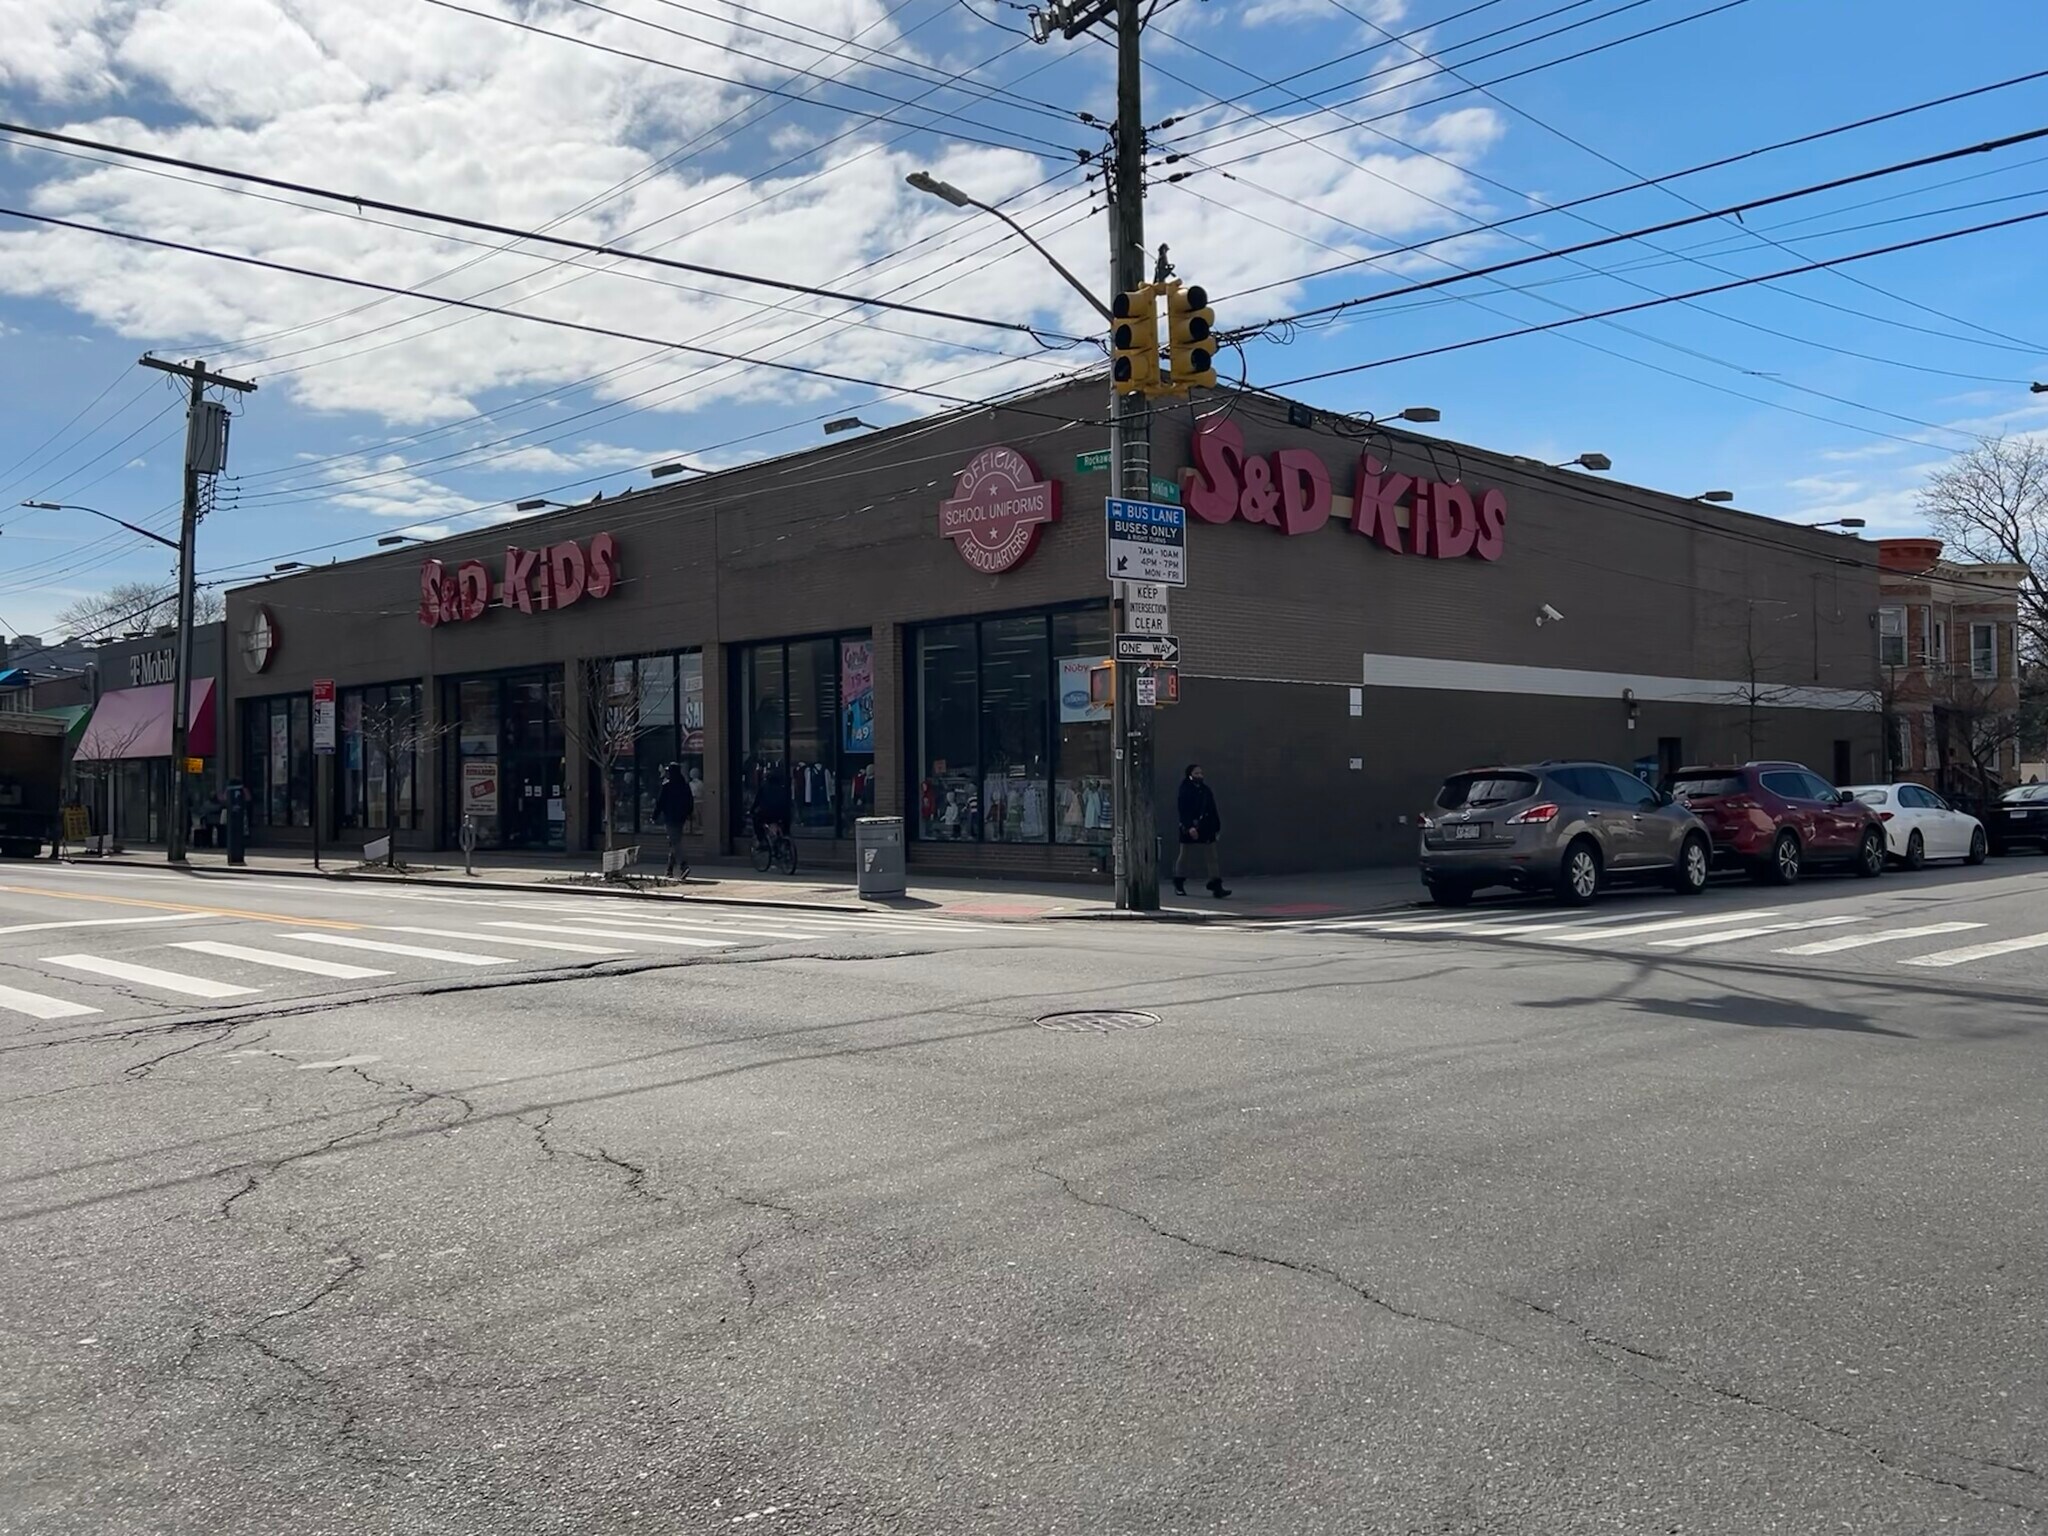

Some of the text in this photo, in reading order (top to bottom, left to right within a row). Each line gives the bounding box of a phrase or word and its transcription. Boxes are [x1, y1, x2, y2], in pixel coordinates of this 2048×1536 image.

[962, 451, 1024, 489] OFFICIAL
[1191, 415, 1332, 536] S&D
[945, 495, 1044, 526] SCHOOL UNIFORMS
[1127, 505, 1180, 524] BUS LANE
[1115, 521, 1178, 538] BUSES ONLY
[1149, 536, 1167, 544] TURNS
[961, 528, 1029, 570] HEADQUARTERS
[1138, 547, 1154, 556] 7AM
[1160, 549, 1179, 558] 10AM
[1140, 558, 1157, 566] 4PM
[1164, 560, 1179, 568] 7PM
[1145, 569, 1161, 577] MON
[1168, 571, 1179, 579] FRI
[419, 558, 490, 629] S&D
[1137, 587, 1159, 599] KEEP
[1130, 603, 1167, 614] INTERSECTION
[1135, 617, 1163, 630] CLEAR
[1121, 642, 1172, 653] ONE WAY
